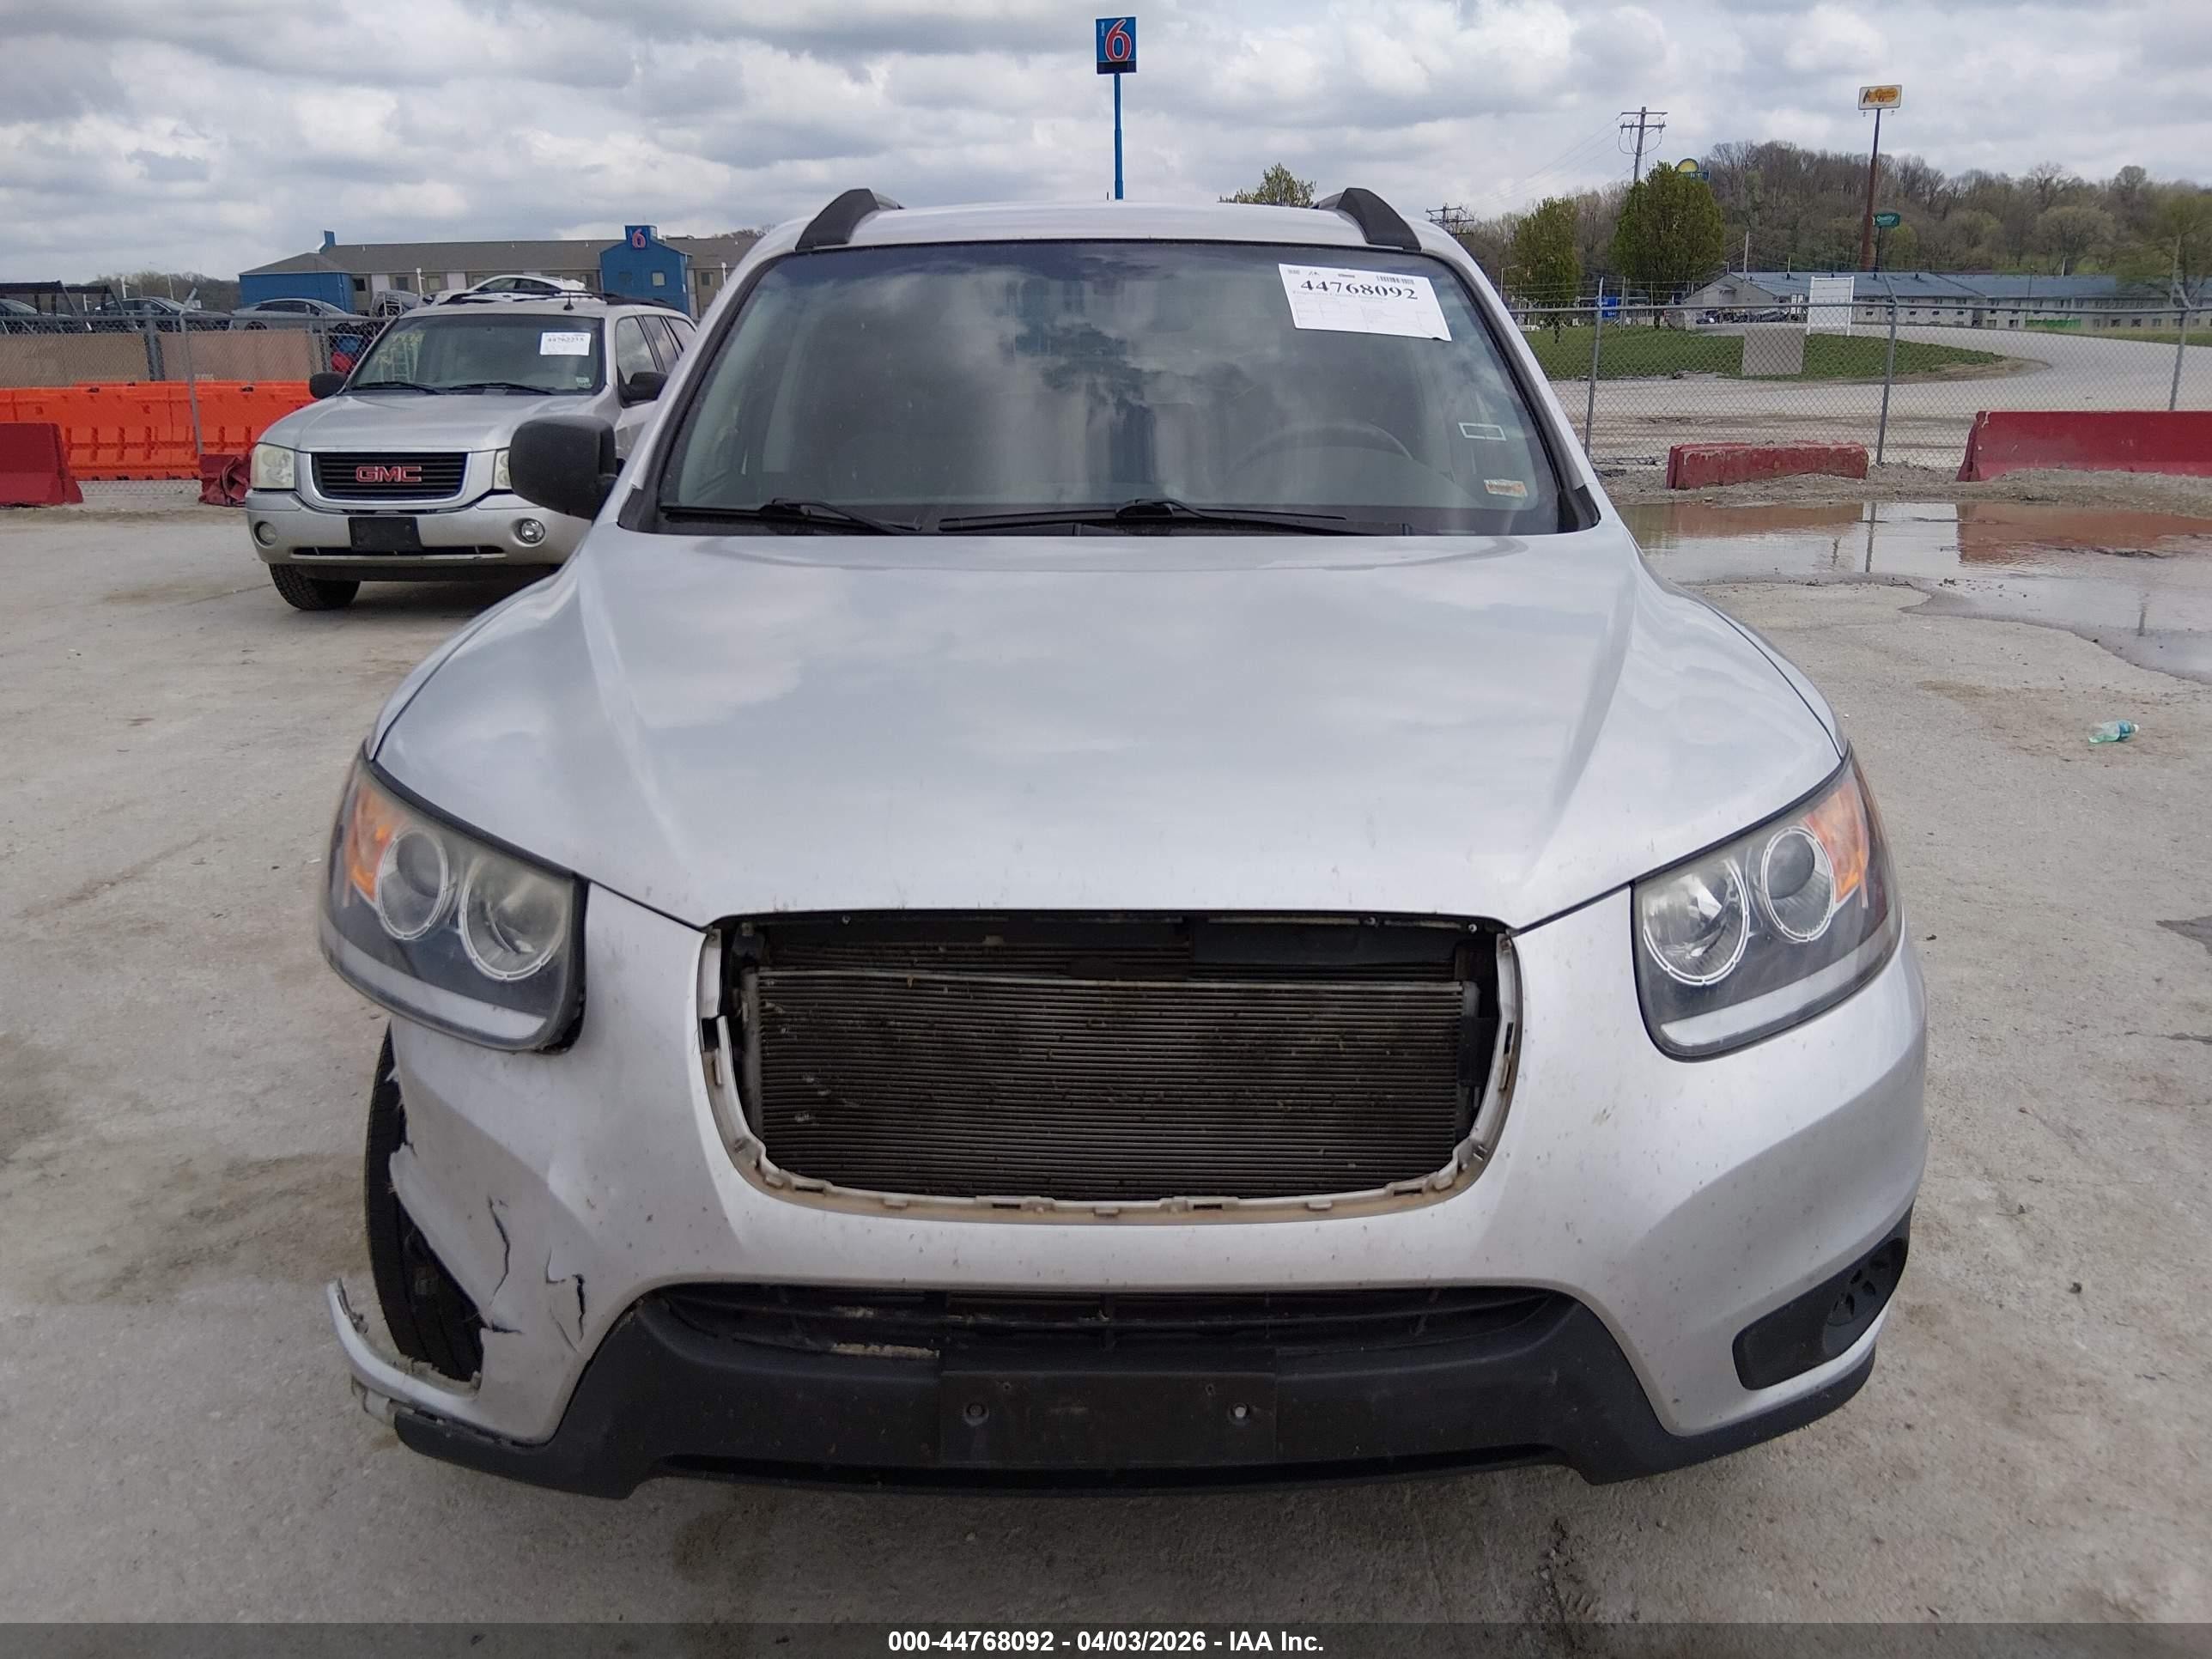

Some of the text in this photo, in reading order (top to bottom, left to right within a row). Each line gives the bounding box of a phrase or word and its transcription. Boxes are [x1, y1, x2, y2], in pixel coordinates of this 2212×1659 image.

[1105, 19, 1132, 61] 6
[632, 228, 646, 248] 6
[1300, 279, 1419, 301] 44768092
[356, 465, 422, 483] GMC
